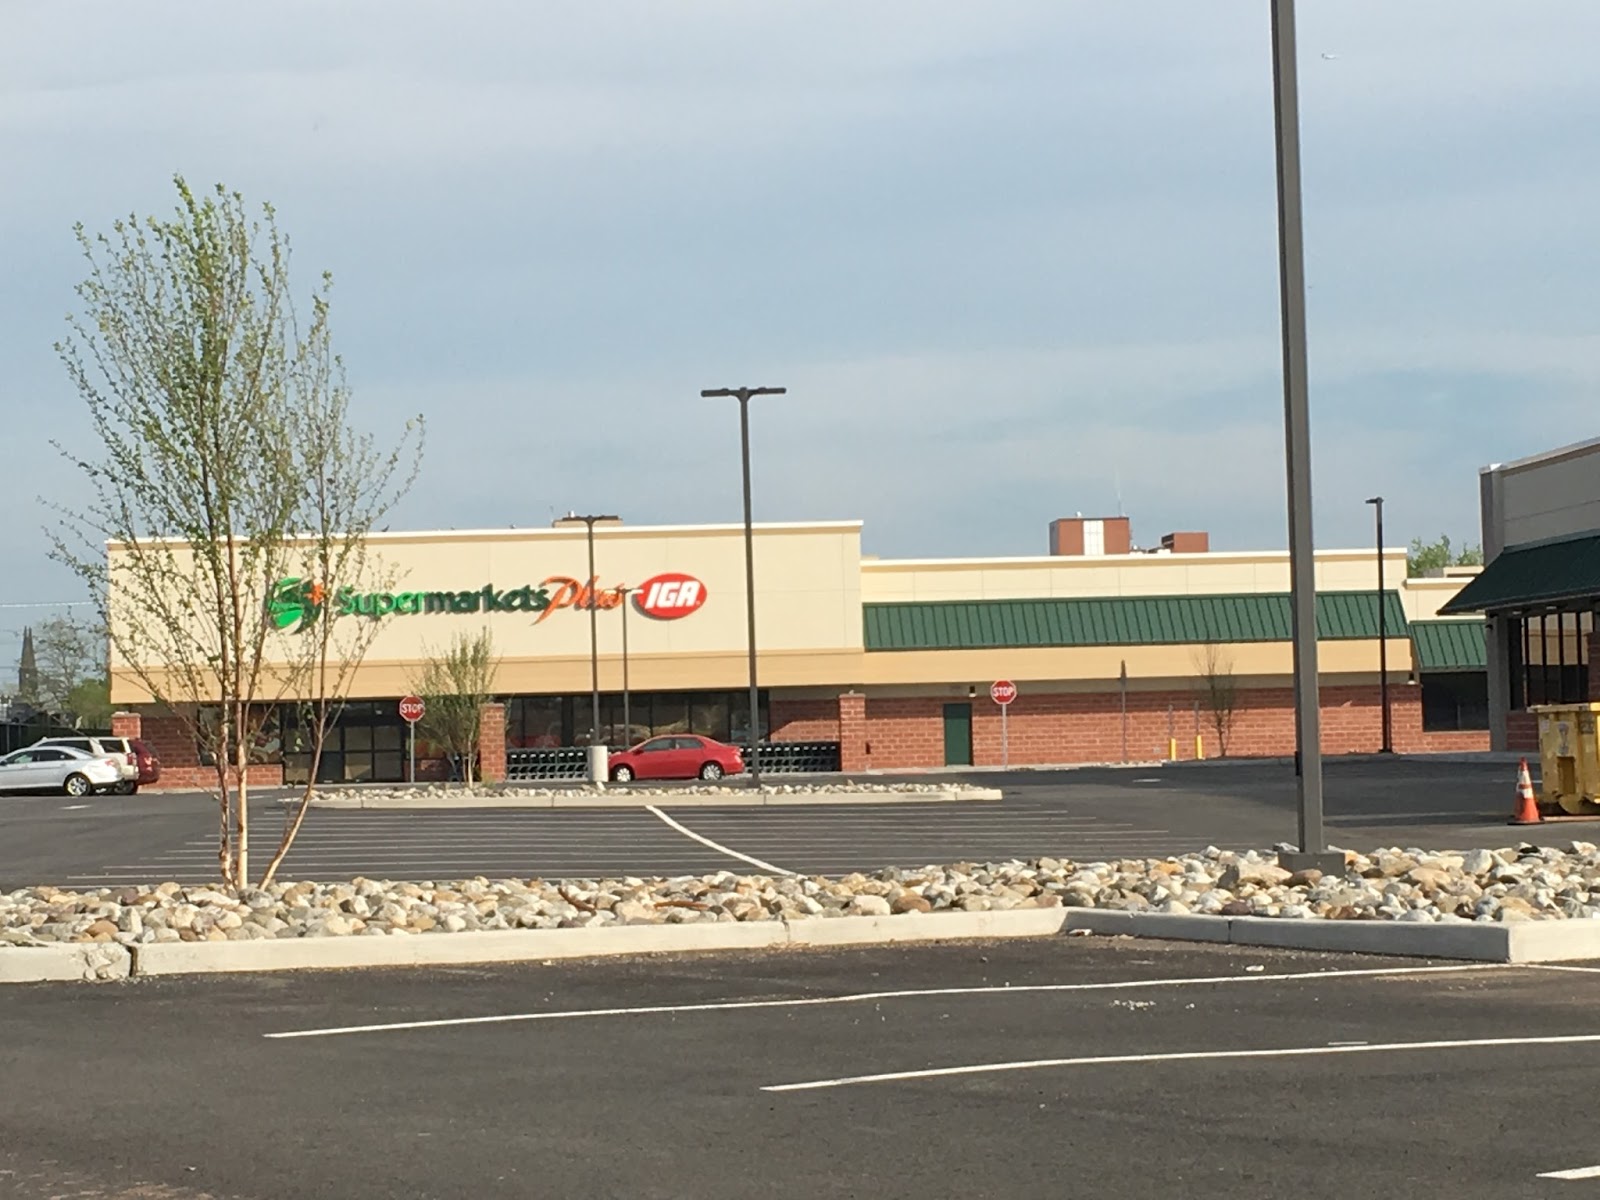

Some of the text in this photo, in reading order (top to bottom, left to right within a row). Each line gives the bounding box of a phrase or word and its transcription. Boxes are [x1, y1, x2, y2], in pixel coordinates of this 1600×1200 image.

[336, 583, 551, 618] Supermarkets
[644, 580, 701, 609] IGA
[993, 686, 1014, 697] STOP
[402, 703, 424, 714] STOP
